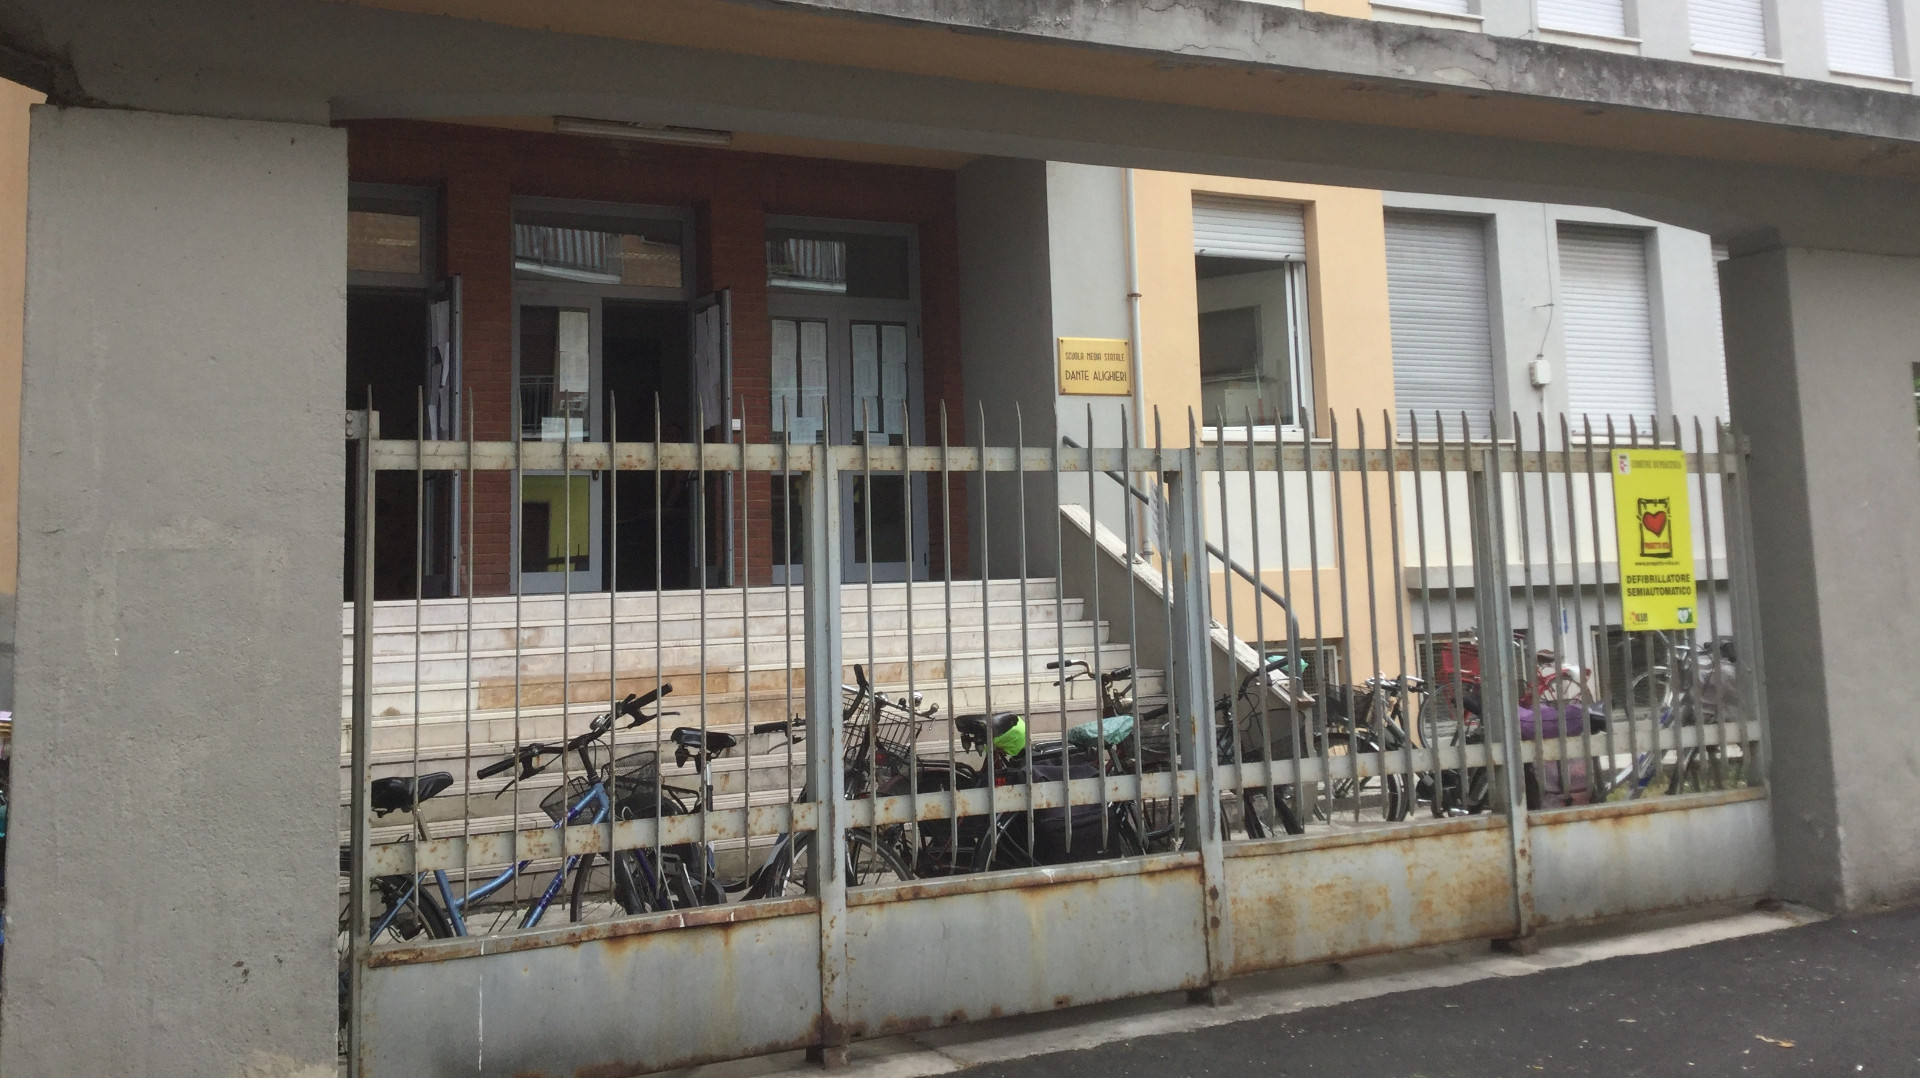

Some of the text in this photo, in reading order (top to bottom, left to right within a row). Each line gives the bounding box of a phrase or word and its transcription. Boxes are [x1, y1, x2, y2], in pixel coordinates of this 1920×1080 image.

[1065, 352, 1125, 362] SCUOLA MEDIA STATALE
[1065, 370, 1127, 382] DANTE ALIGHIERI
[1626, 573, 1691, 584] DEFIBRILLATORE
[1627, 586, 1692, 597] SEMIAUTOMATICO
